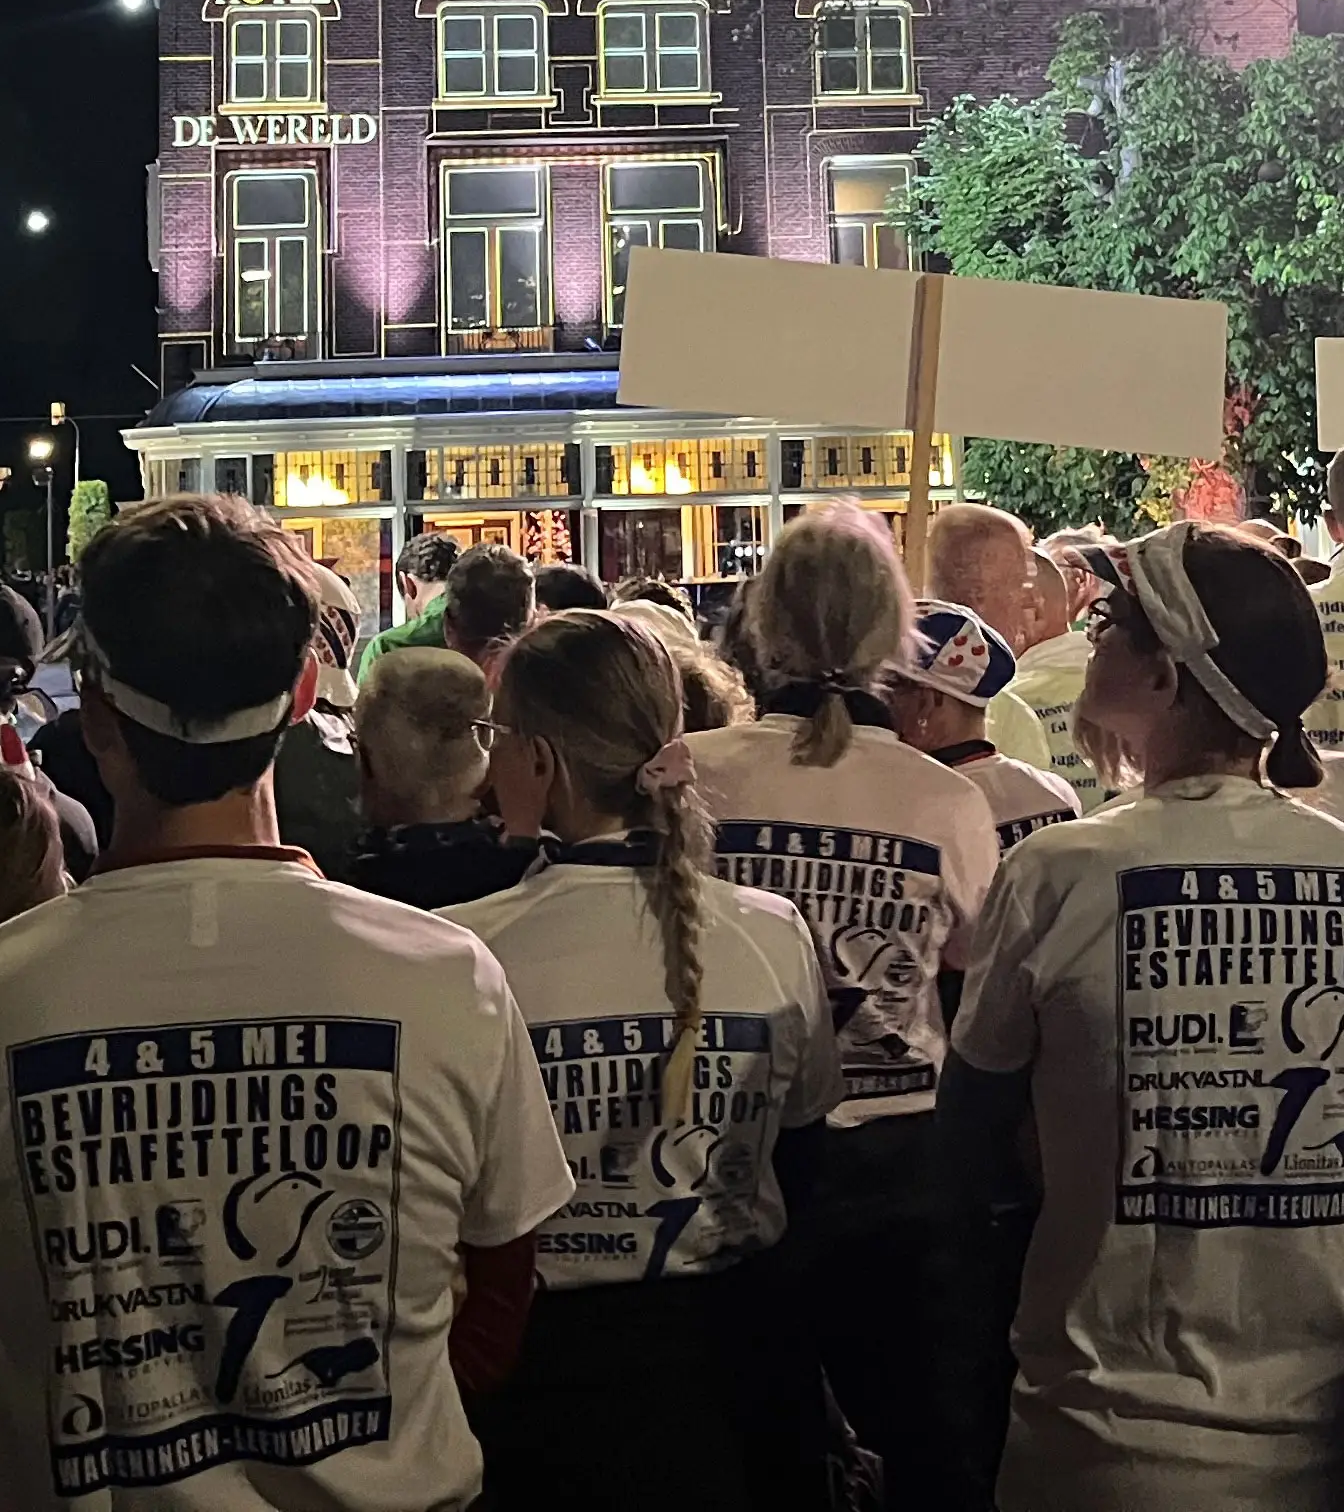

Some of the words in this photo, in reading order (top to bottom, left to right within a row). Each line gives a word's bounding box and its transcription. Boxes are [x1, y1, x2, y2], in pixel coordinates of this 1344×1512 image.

[171, 115, 220, 147] DE
[228, 113, 378, 145] WERELD
[756, 826, 773, 850] 4
[787, 831, 806, 855] &
[817, 831, 836, 857] 5
[849, 833, 904, 866] MEI
[1180, 870, 1199, 901] 4
[1218, 874, 1239, 901] &
[1256, 871, 1276, 901] 5
[778, 891, 929, 934] ETTELOOP
[84, 1038, 110, 1077] 4
[135, 1040, 164, 1074] &
[190, 1029, 215, 1069] 5
[242, 1024, 327, 1067] MEI
[544, 1027, 564, 1059] 4
[583, 1028, 605, 1055] &
[622, 1019, 643, 1051] 5
[1128, 1013, 1224, 1047] RUDI.
[540, 1054, 733, 1101] VRIJDIGS
[20, 1072, 338, 1148] BEVRIJDINGS
[1132, 1104, 1260, 1131] HESSING
[23, 1123, 392, 1195] ESTAFETTELOOP
[44, 1216, 151, 1266] RUDI.
[536, 1232, 637, 1254] ESSING
[54, 1324, 206, 1375] HESSING
